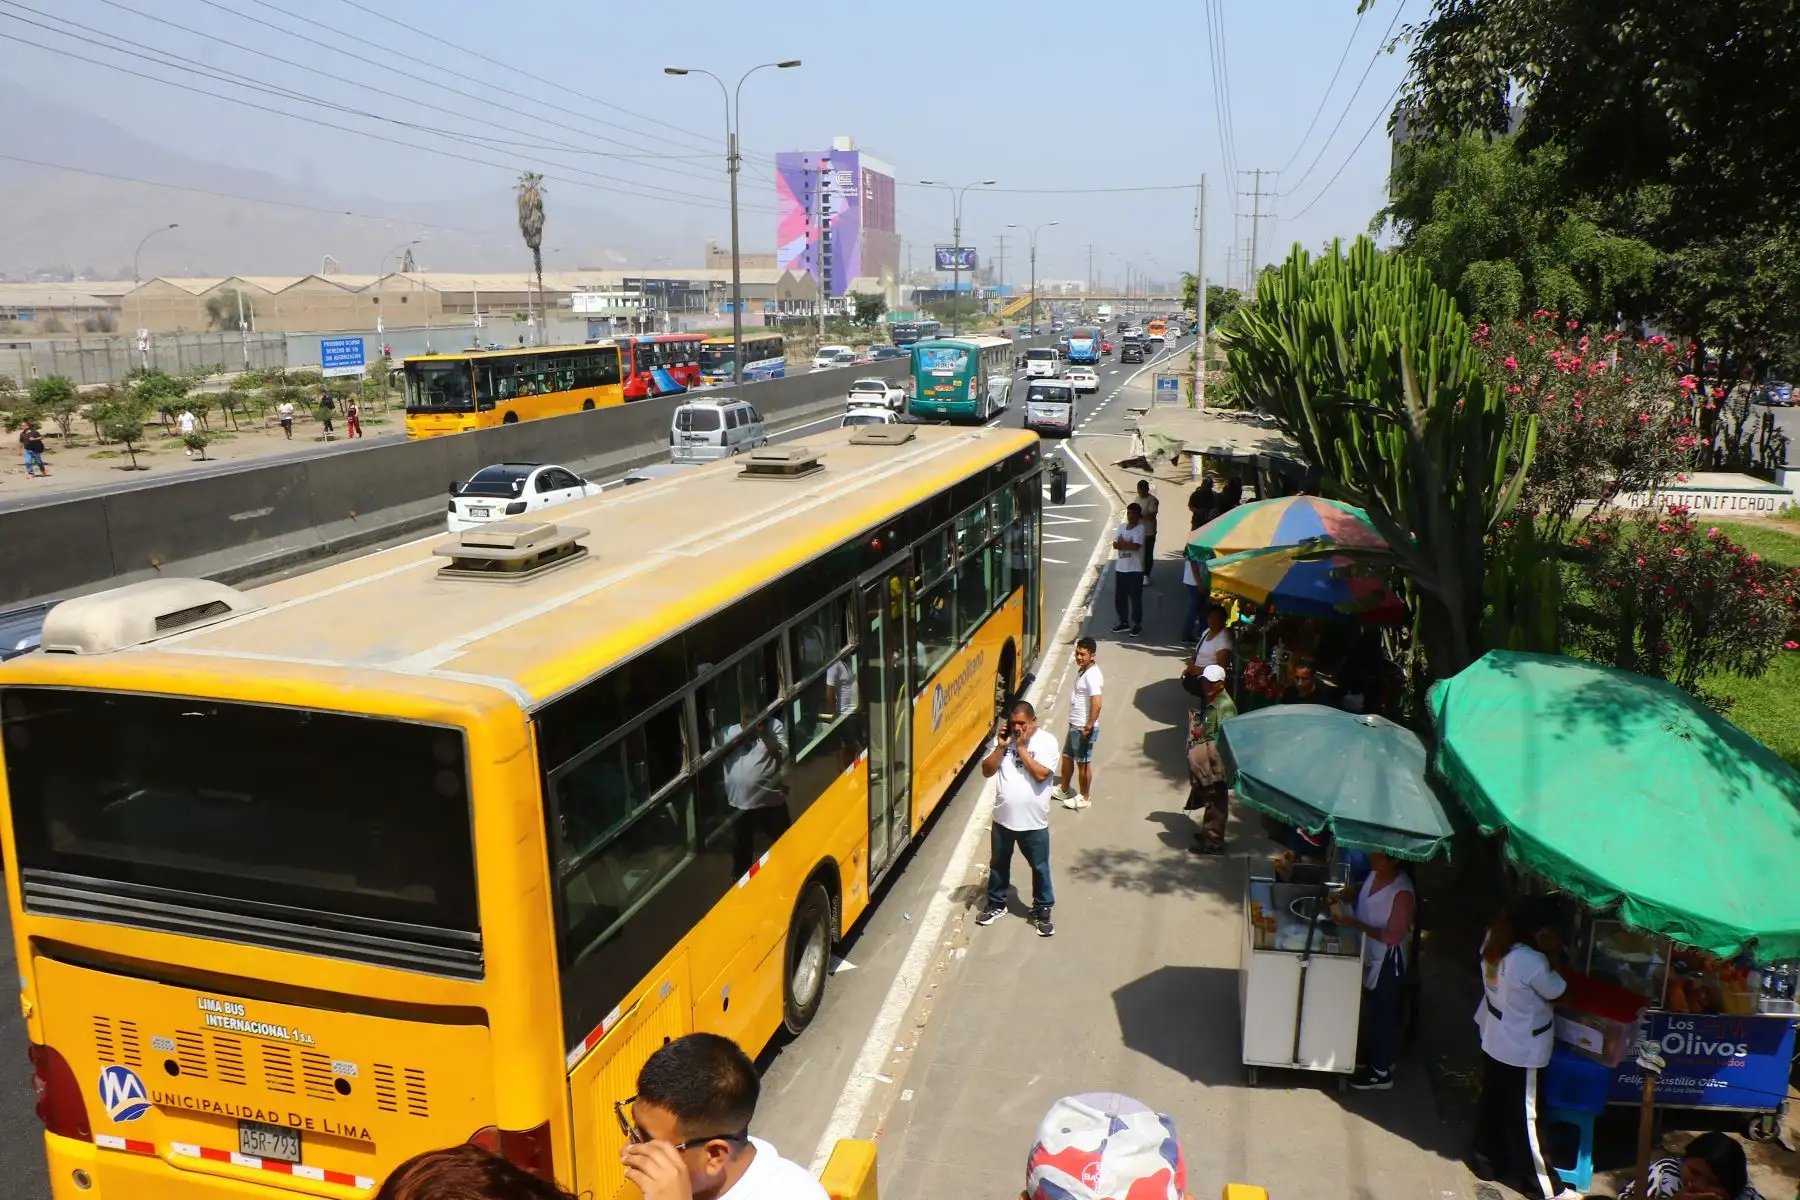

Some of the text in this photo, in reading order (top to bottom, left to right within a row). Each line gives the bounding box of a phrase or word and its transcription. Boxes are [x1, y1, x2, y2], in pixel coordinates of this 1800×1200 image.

[197, 997, 246, 1017] LIMA BUS
[206, 1013, 316, 1045] INTERNACIONAL 1 S.A.
[1667, 1017, 1695, 1031] Los
[1661, 1032, 1748, 1058] Olivos
[1617, 1074, 1645, 1087] Felip
[323, 1118, 372, 1141] LIMA
[242, 1130, 299, 1156] A5R-793
